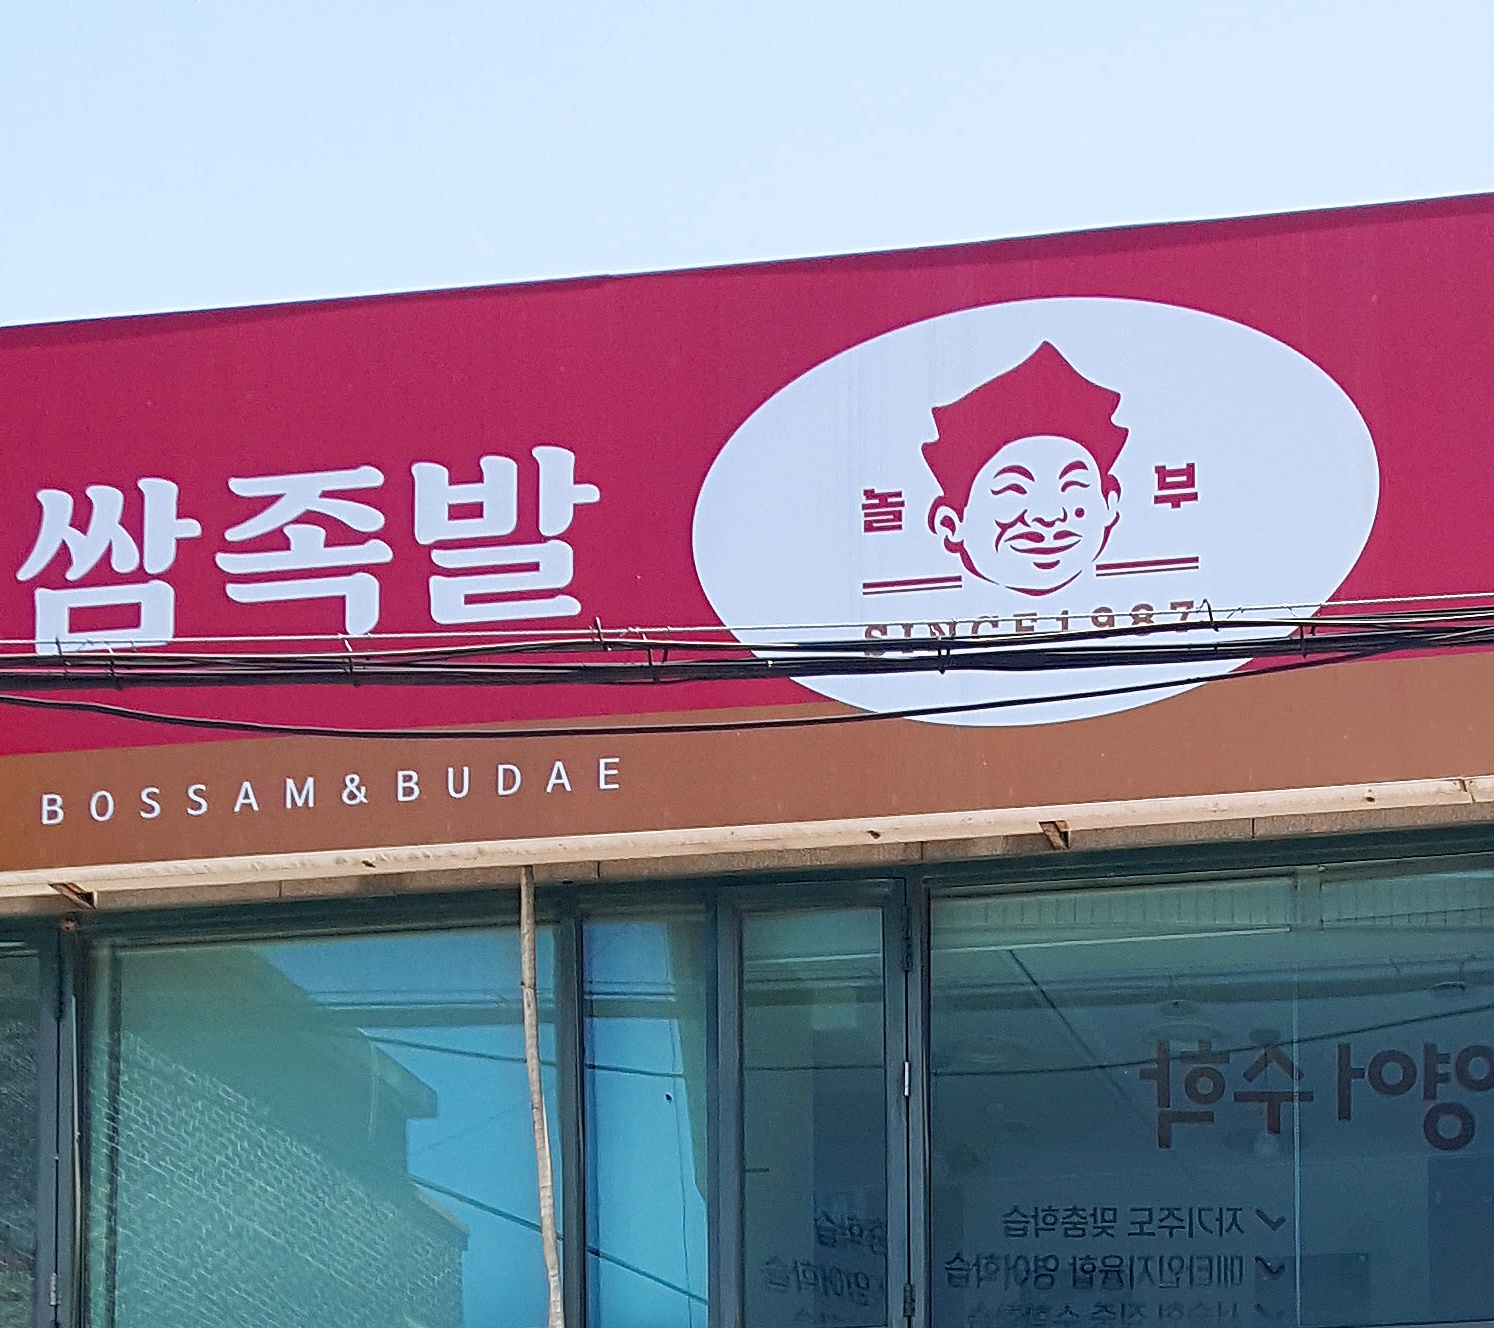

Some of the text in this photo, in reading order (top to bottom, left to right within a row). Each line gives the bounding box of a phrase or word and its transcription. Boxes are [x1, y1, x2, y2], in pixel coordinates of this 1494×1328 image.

[861, 462, 1199, 533] 놀 부
[15, 445, 601, 656] 쌈족발
[40, 757, 621, 826] BOSSAM&BUDAE
